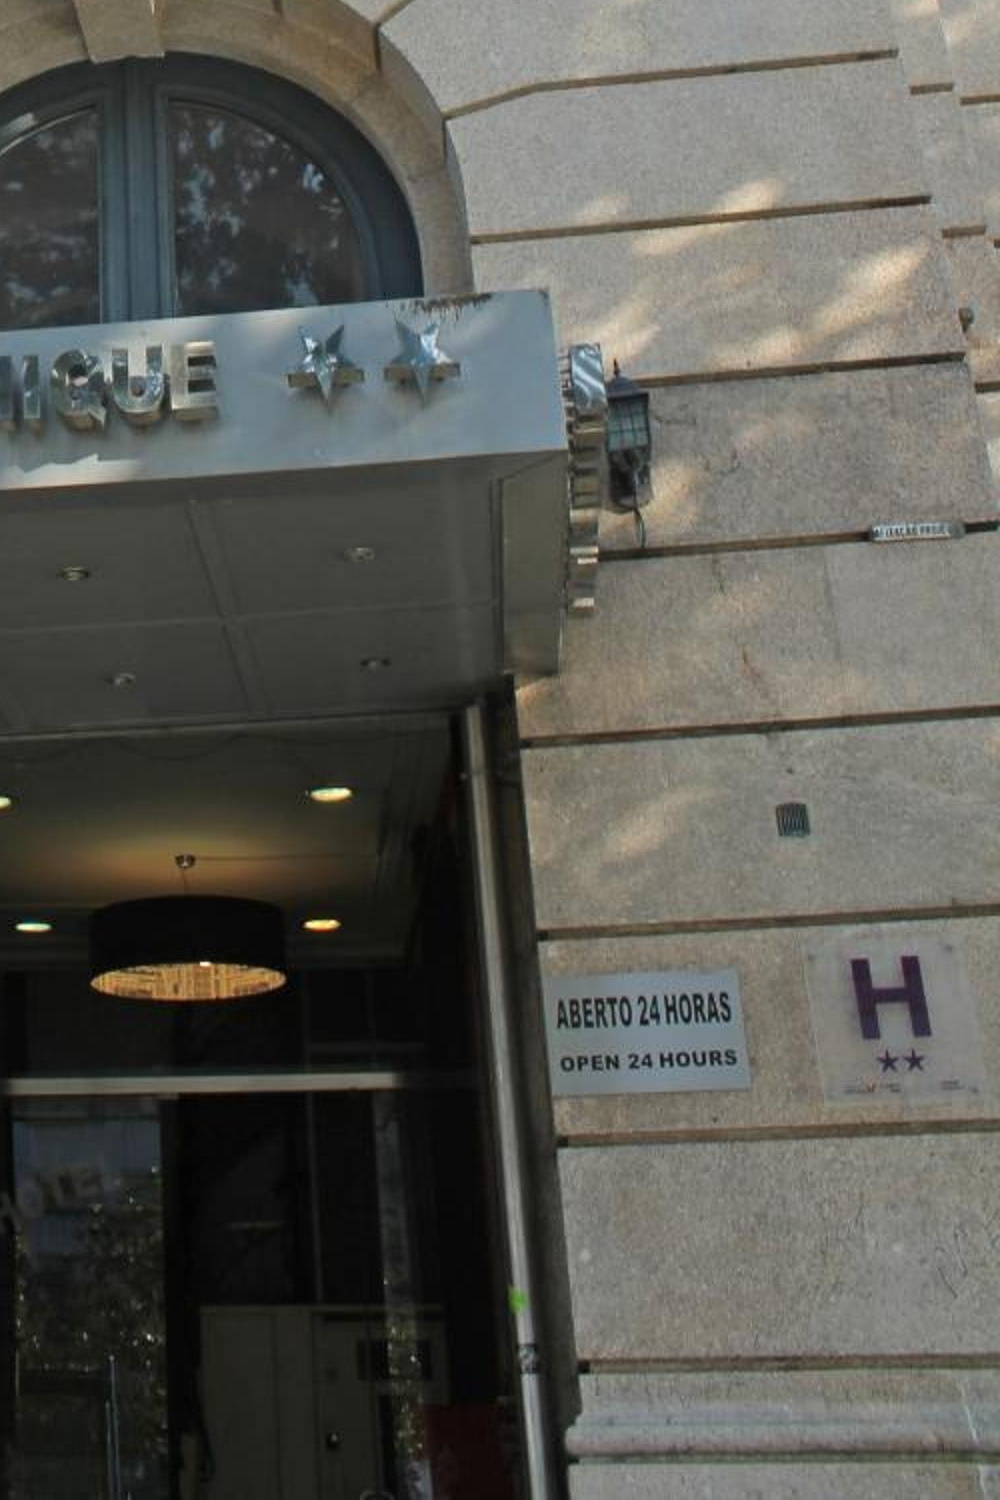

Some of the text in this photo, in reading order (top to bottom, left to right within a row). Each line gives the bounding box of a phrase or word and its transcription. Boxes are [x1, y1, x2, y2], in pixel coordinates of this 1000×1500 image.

[557, 992, 732, 1029] ABERTO 24 HORAS
[850, 955, 932, 1039] H
[560, 1050, 738, 1072] OPEN 24 HOURS
